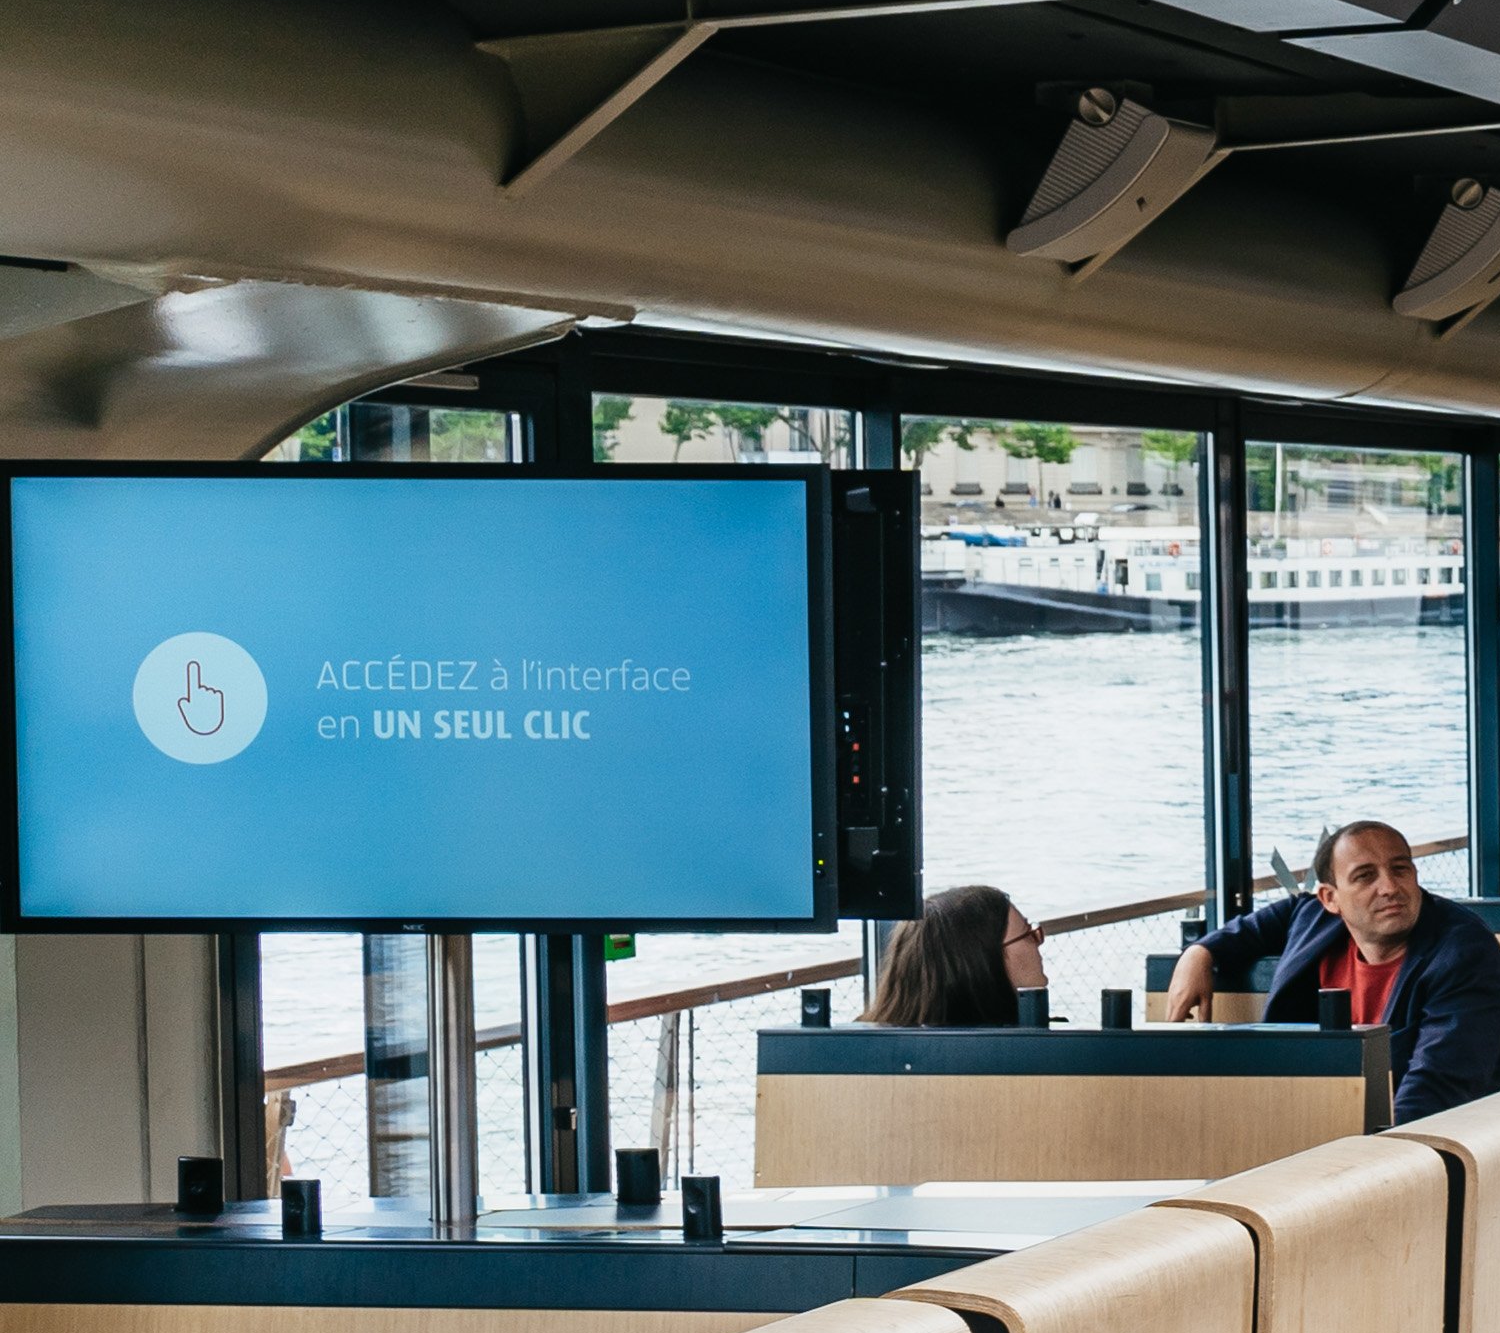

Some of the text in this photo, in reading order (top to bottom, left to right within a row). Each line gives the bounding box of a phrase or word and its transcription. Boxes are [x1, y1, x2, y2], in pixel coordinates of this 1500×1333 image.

[316, 653, 692, 691] ACCÉDEZ à l'interface
[317, 709, 591, 740] en UN SEUL CLIC
